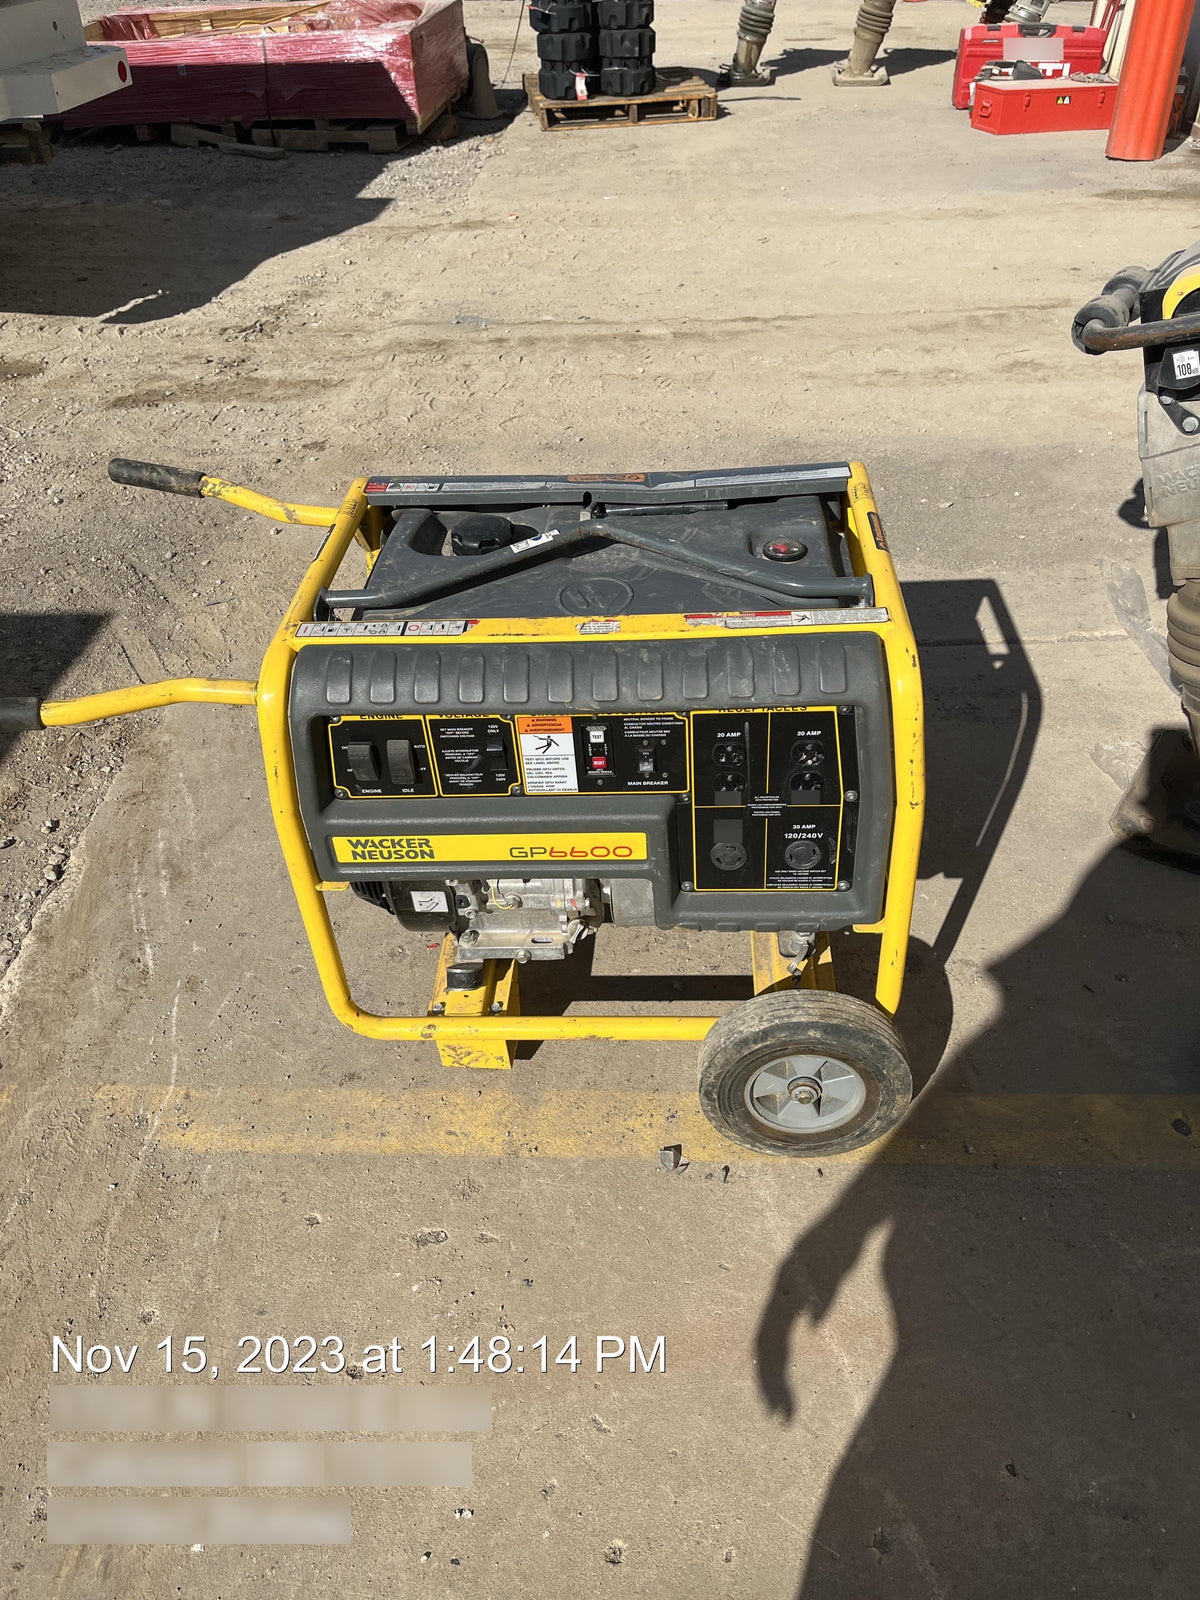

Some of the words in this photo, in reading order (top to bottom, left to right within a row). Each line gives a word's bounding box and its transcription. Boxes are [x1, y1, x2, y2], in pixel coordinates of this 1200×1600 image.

[1177, 363, 1192, 376] 108
[347, 838, 432, 849] WACKER
[351, 849, 435, 860] NEUSON
[509, 846, 633, 858] GP6600
